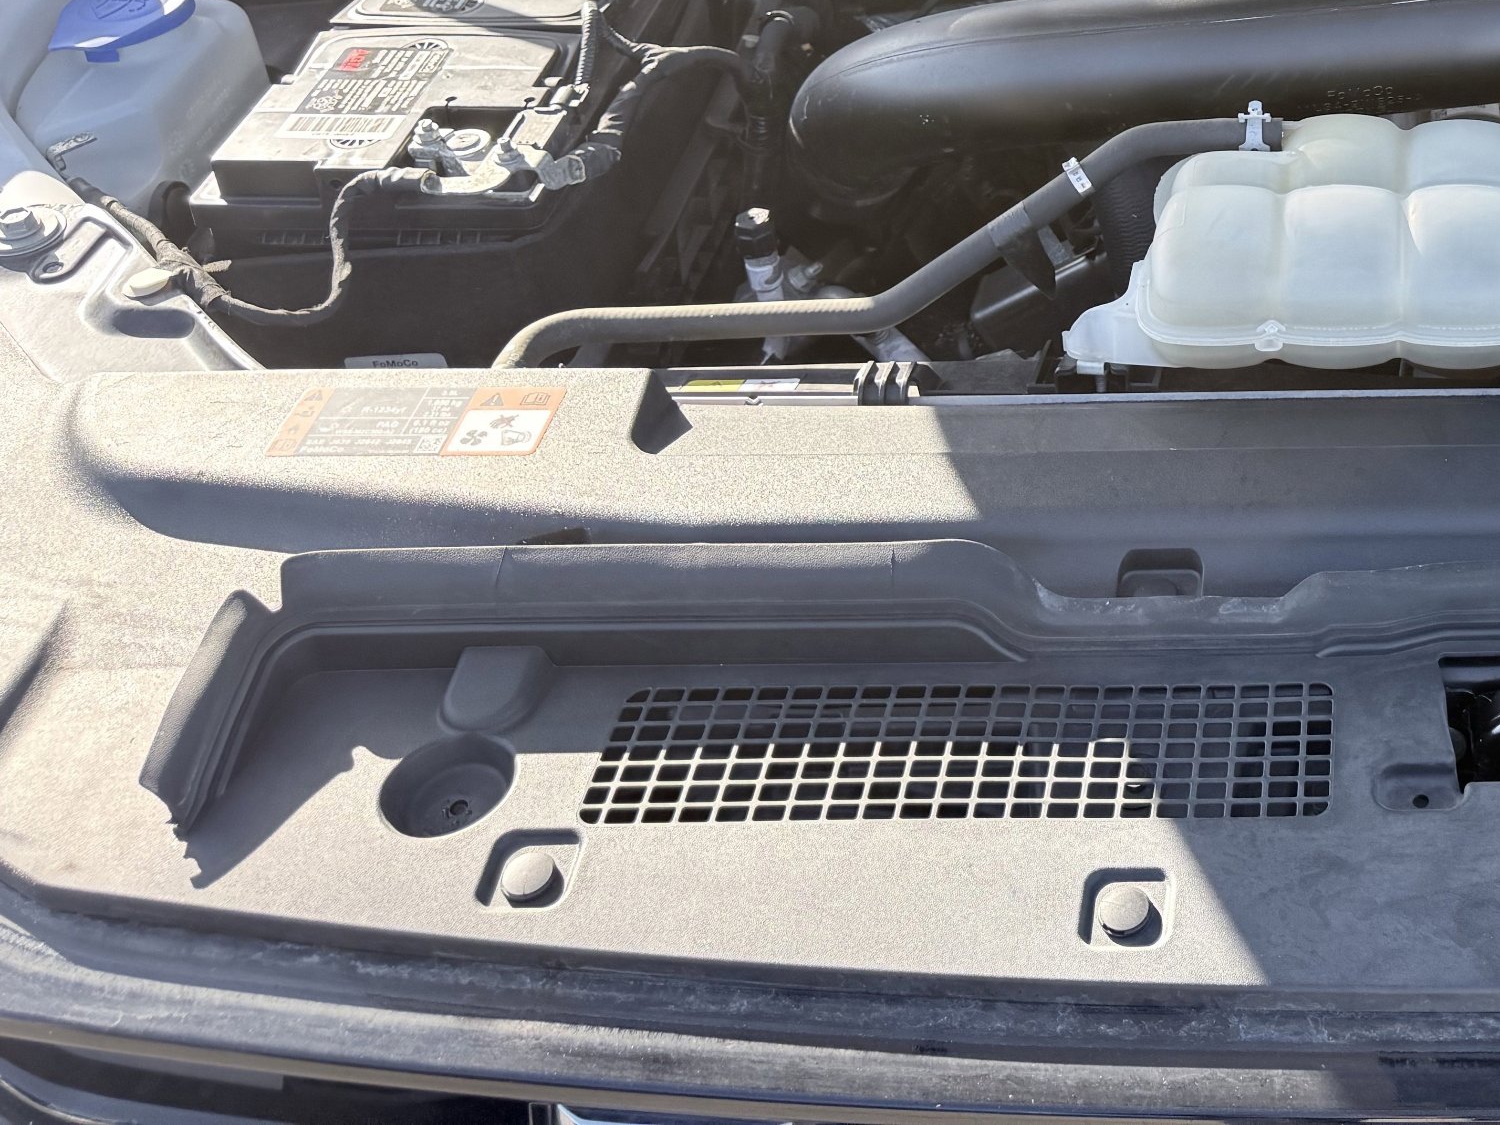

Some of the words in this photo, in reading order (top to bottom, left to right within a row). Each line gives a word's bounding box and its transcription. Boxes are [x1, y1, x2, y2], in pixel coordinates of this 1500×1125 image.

[1327, 85, 1394, 100] FooCo
[372, 359, 419, 368] FoMoCo
[360, 406, 408, 415] R-1234yf
